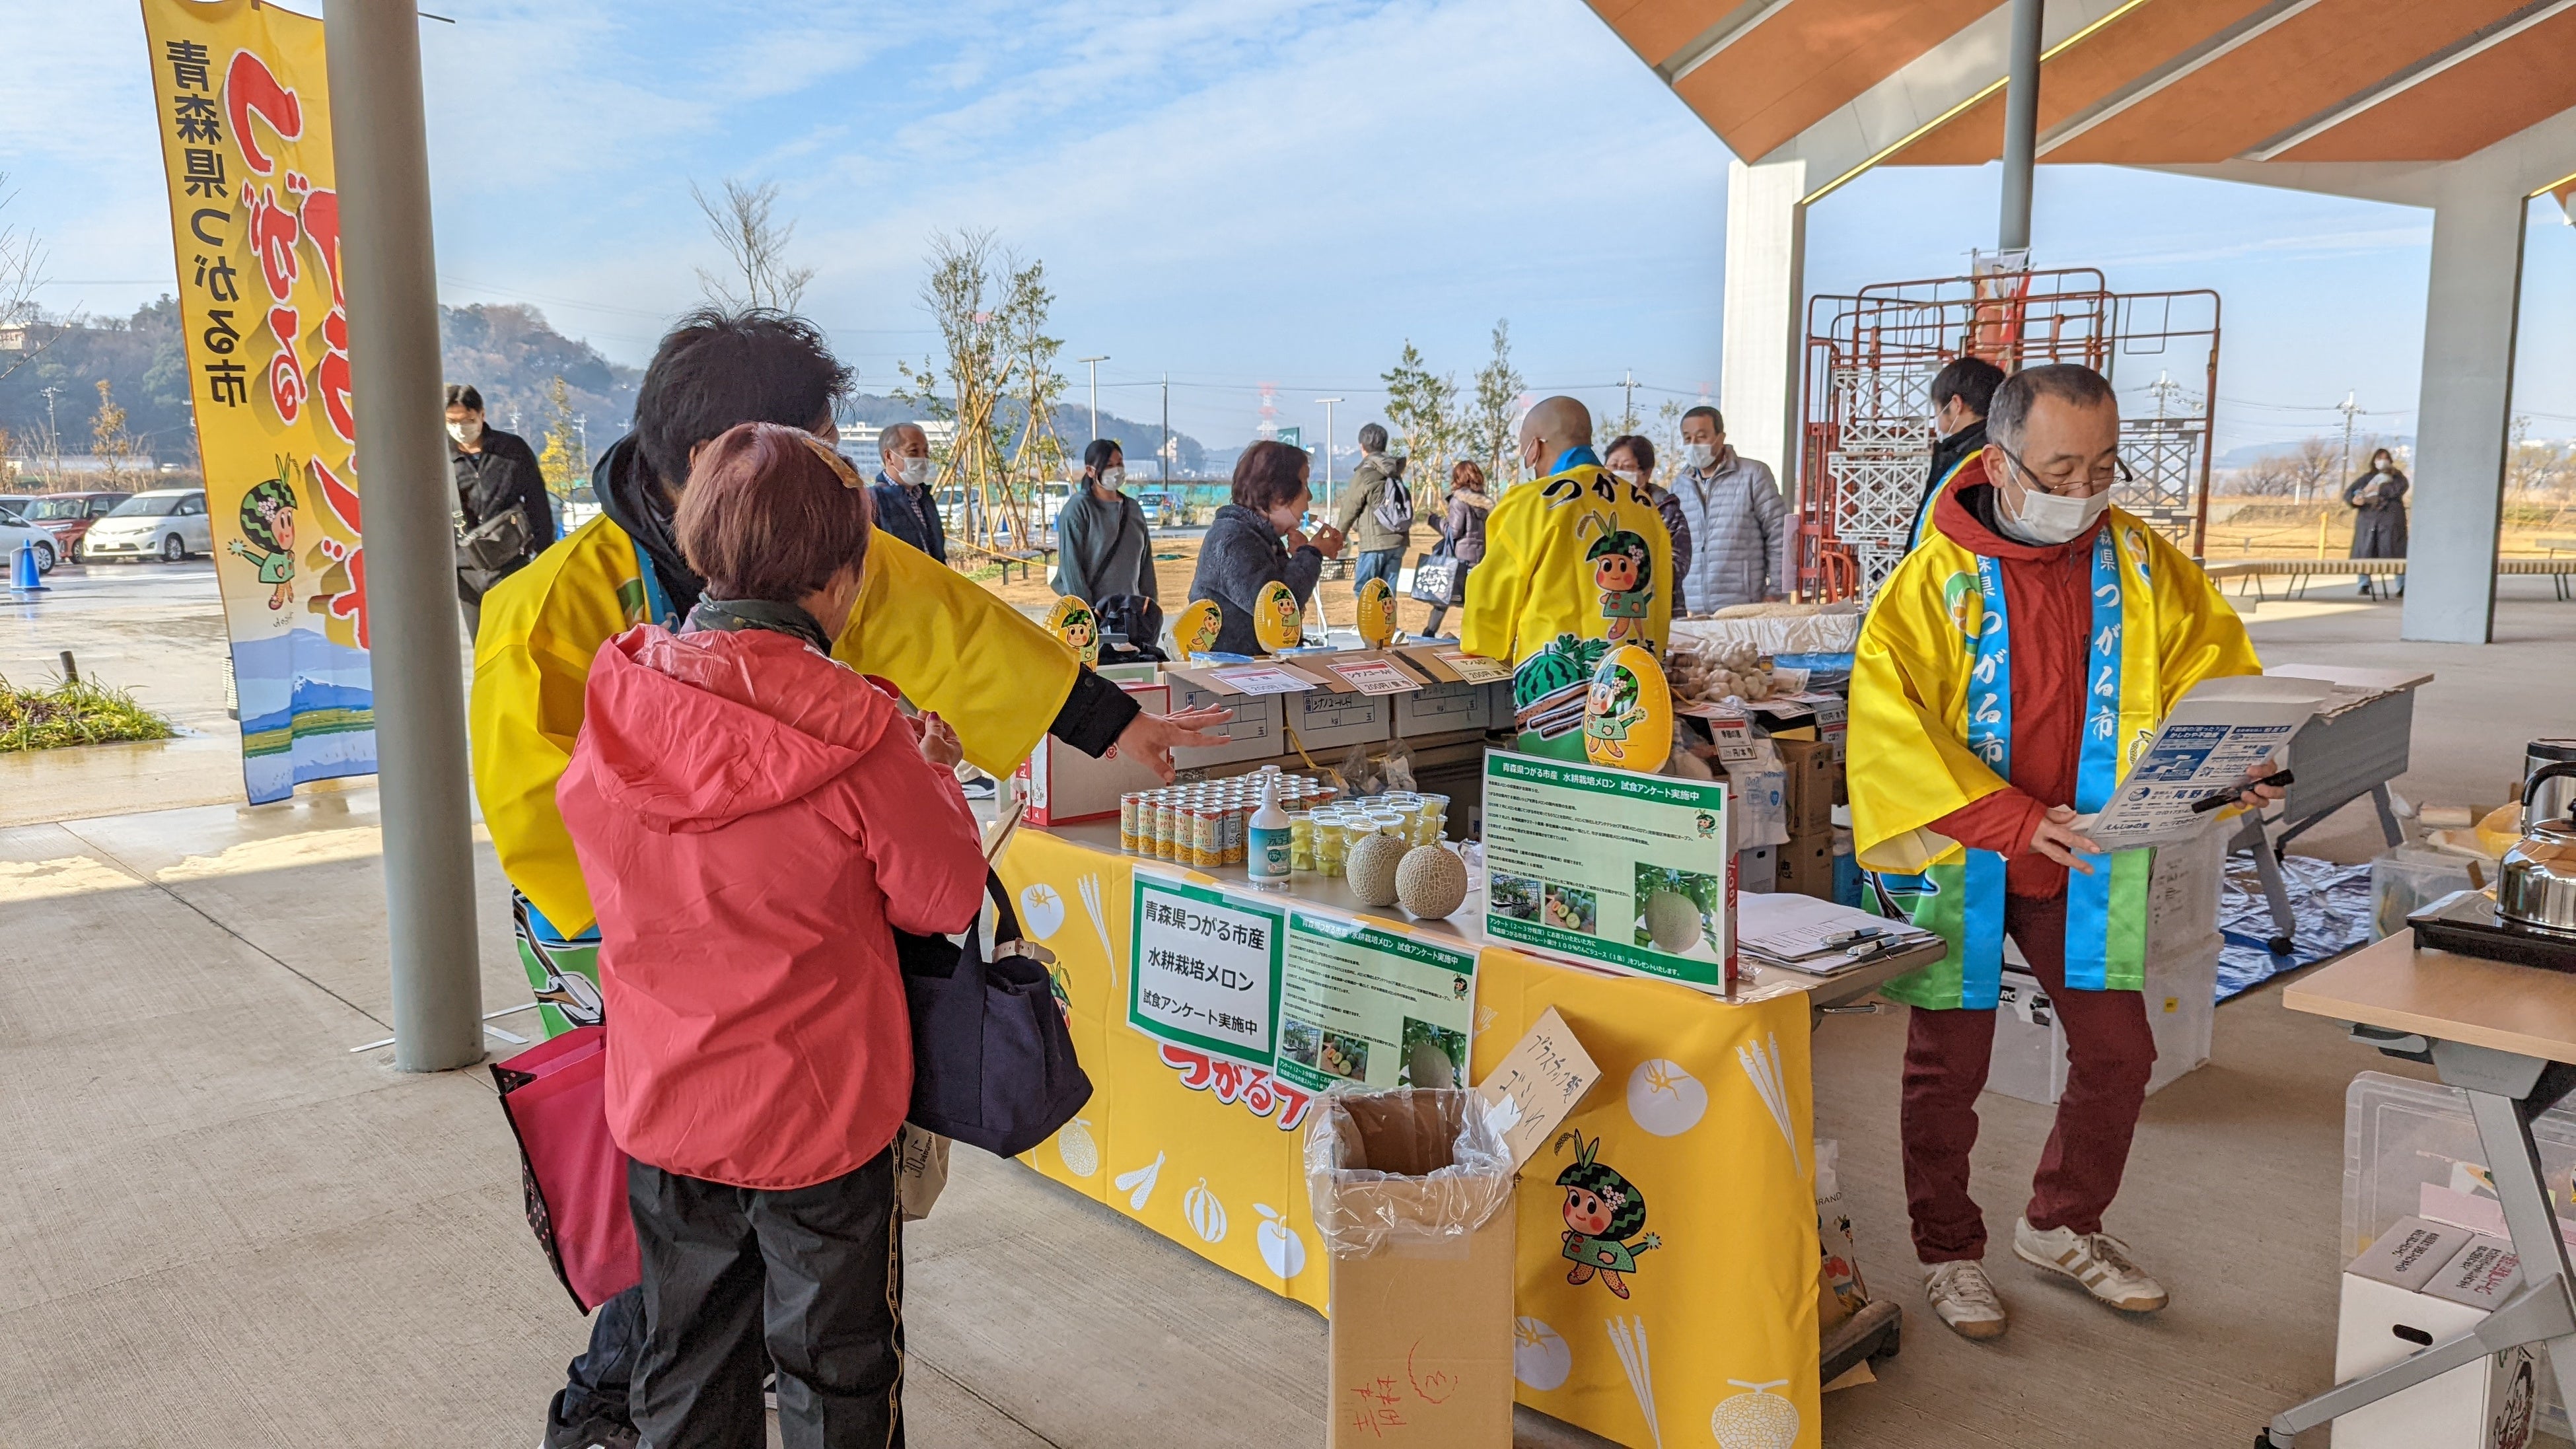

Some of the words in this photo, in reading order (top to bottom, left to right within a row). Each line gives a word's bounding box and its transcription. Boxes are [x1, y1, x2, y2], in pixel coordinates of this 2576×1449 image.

[1503, 762, 1557, 781] 青森県つがる市産
[1563, 772, 1616, 789] 水耕栽培メロン
[1620, 780, 1699, 801] 試食アンケート実施中
[1146, 900, 1265, 950] 青森県つがる市産
[1147, 946, 1254, 991] 水耕栽培メロン
[1351, 932, 1394, 948] 水耕栽培メロン
[1397, 942, 1458, 966] 試食アンケート実施中
[1143, 988, 1258, 1036] 試食アンケート実施中
